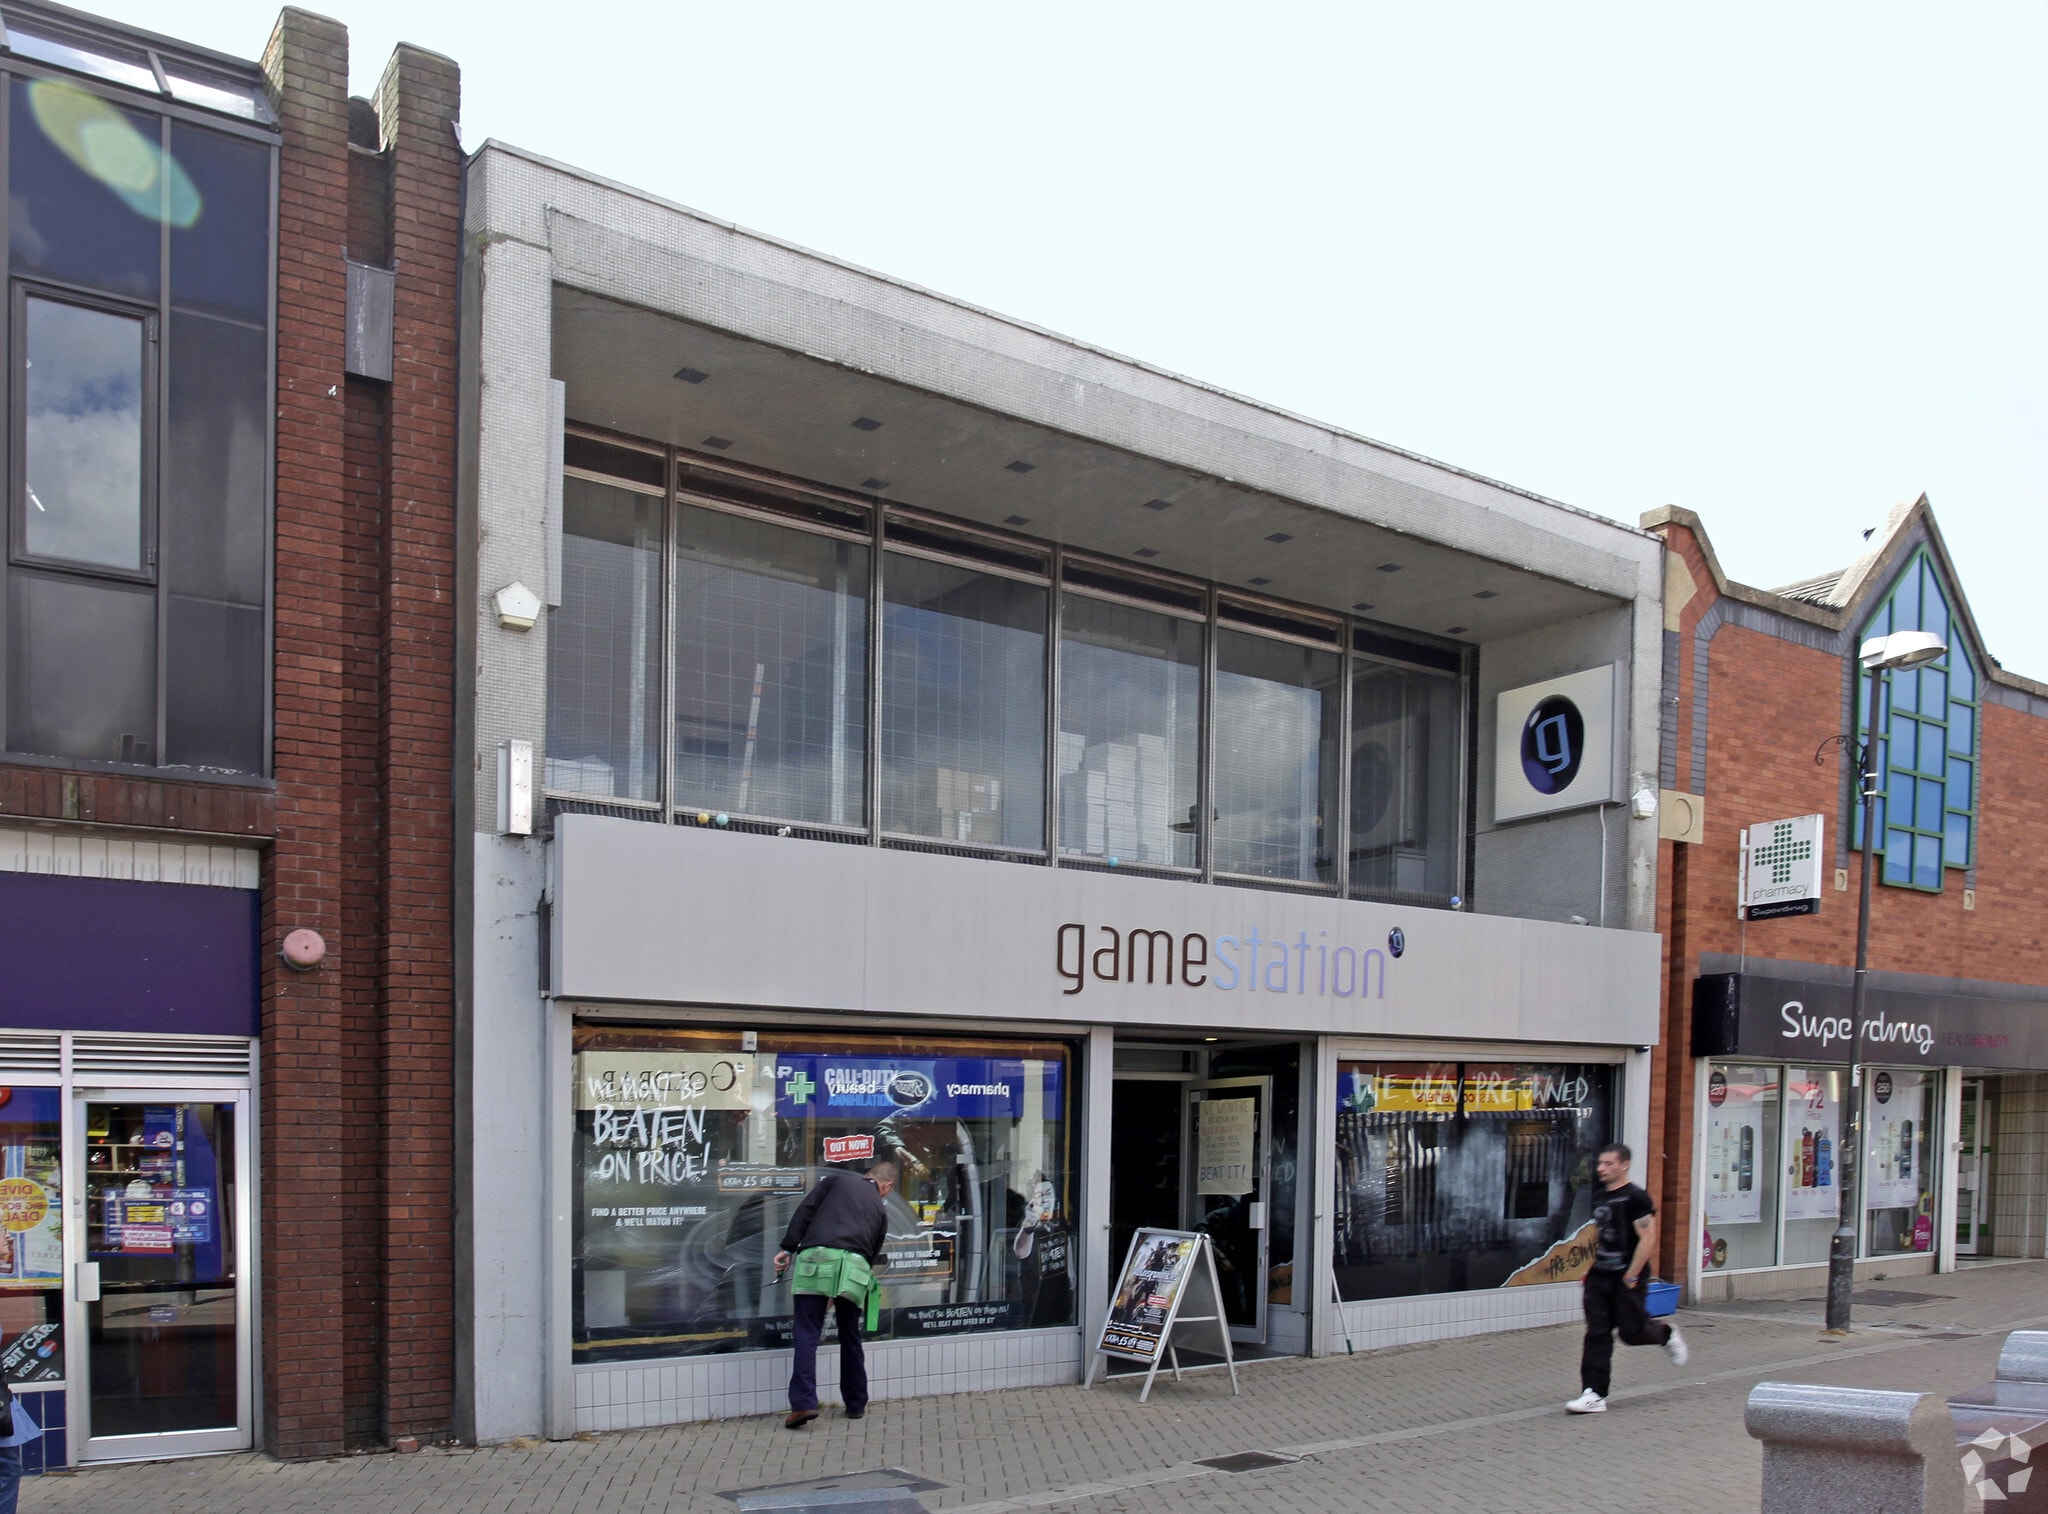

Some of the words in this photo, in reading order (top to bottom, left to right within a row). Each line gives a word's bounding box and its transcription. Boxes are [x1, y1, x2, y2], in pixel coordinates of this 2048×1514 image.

[1535, 713, 1571, 775] g
[1752, 884, 1810, 903] pharmacy
[1751, 904, 1809, 917] Superdrug
[1056, 922, 1385, 999] gamestation
[1780, 1000, 1936, 1056] Superdrug
[592, 1104, 707, 1150] BEATEN
[830, 1141, 847, 1153] OUT
[848, 1139, 869, 1151] NOW!
[600, 1150, 632, 1184] ON
[638, 1142, 711, 1185] PRICE!
[1200, 1165, 1224, 1181] BEAT
[743, 1175, 758, 1187] £5
[591, 1207, 609, 1217] FIND
[610, 1207, 617, 1217] A
[618, 1207, 645, 1216] BETTER
[646, 1206, 668, 1216] PRICE
[669, 1206, 708, 1215] ANYWHERE
[615, 1218, 623, 1227] &
[646, 1217, 671, 1226] MATCH
[895, 1260, 921, 1268] SELECTED
[946, 1306, 973, 1318] BEATEN
